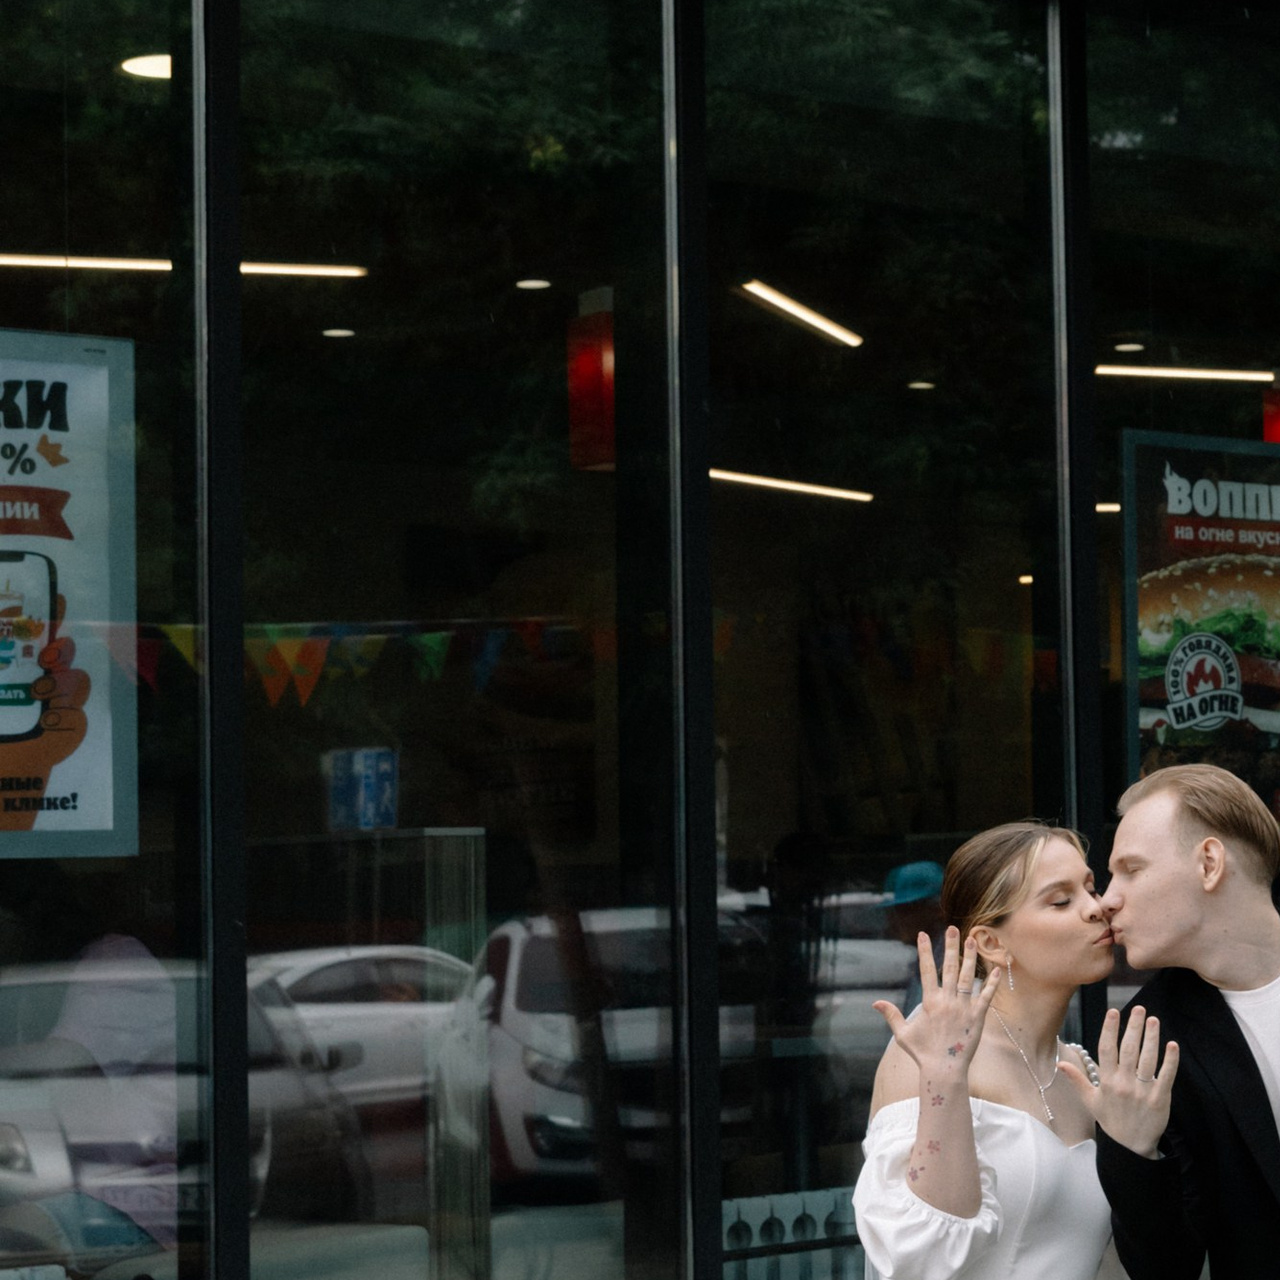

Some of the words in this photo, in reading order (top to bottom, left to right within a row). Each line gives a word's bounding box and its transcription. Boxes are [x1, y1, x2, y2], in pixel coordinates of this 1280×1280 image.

[1174, 525, 1194, 541] на
[1198, 527, 1235, 543] огне
[1181, 639, 1236, 685] ГОВЯДИНА
[1172, 702, 1197, 725] НА
[1198, 694, 1239, 716] ОГНЕ
[3, 792, 79, 812] клике!
